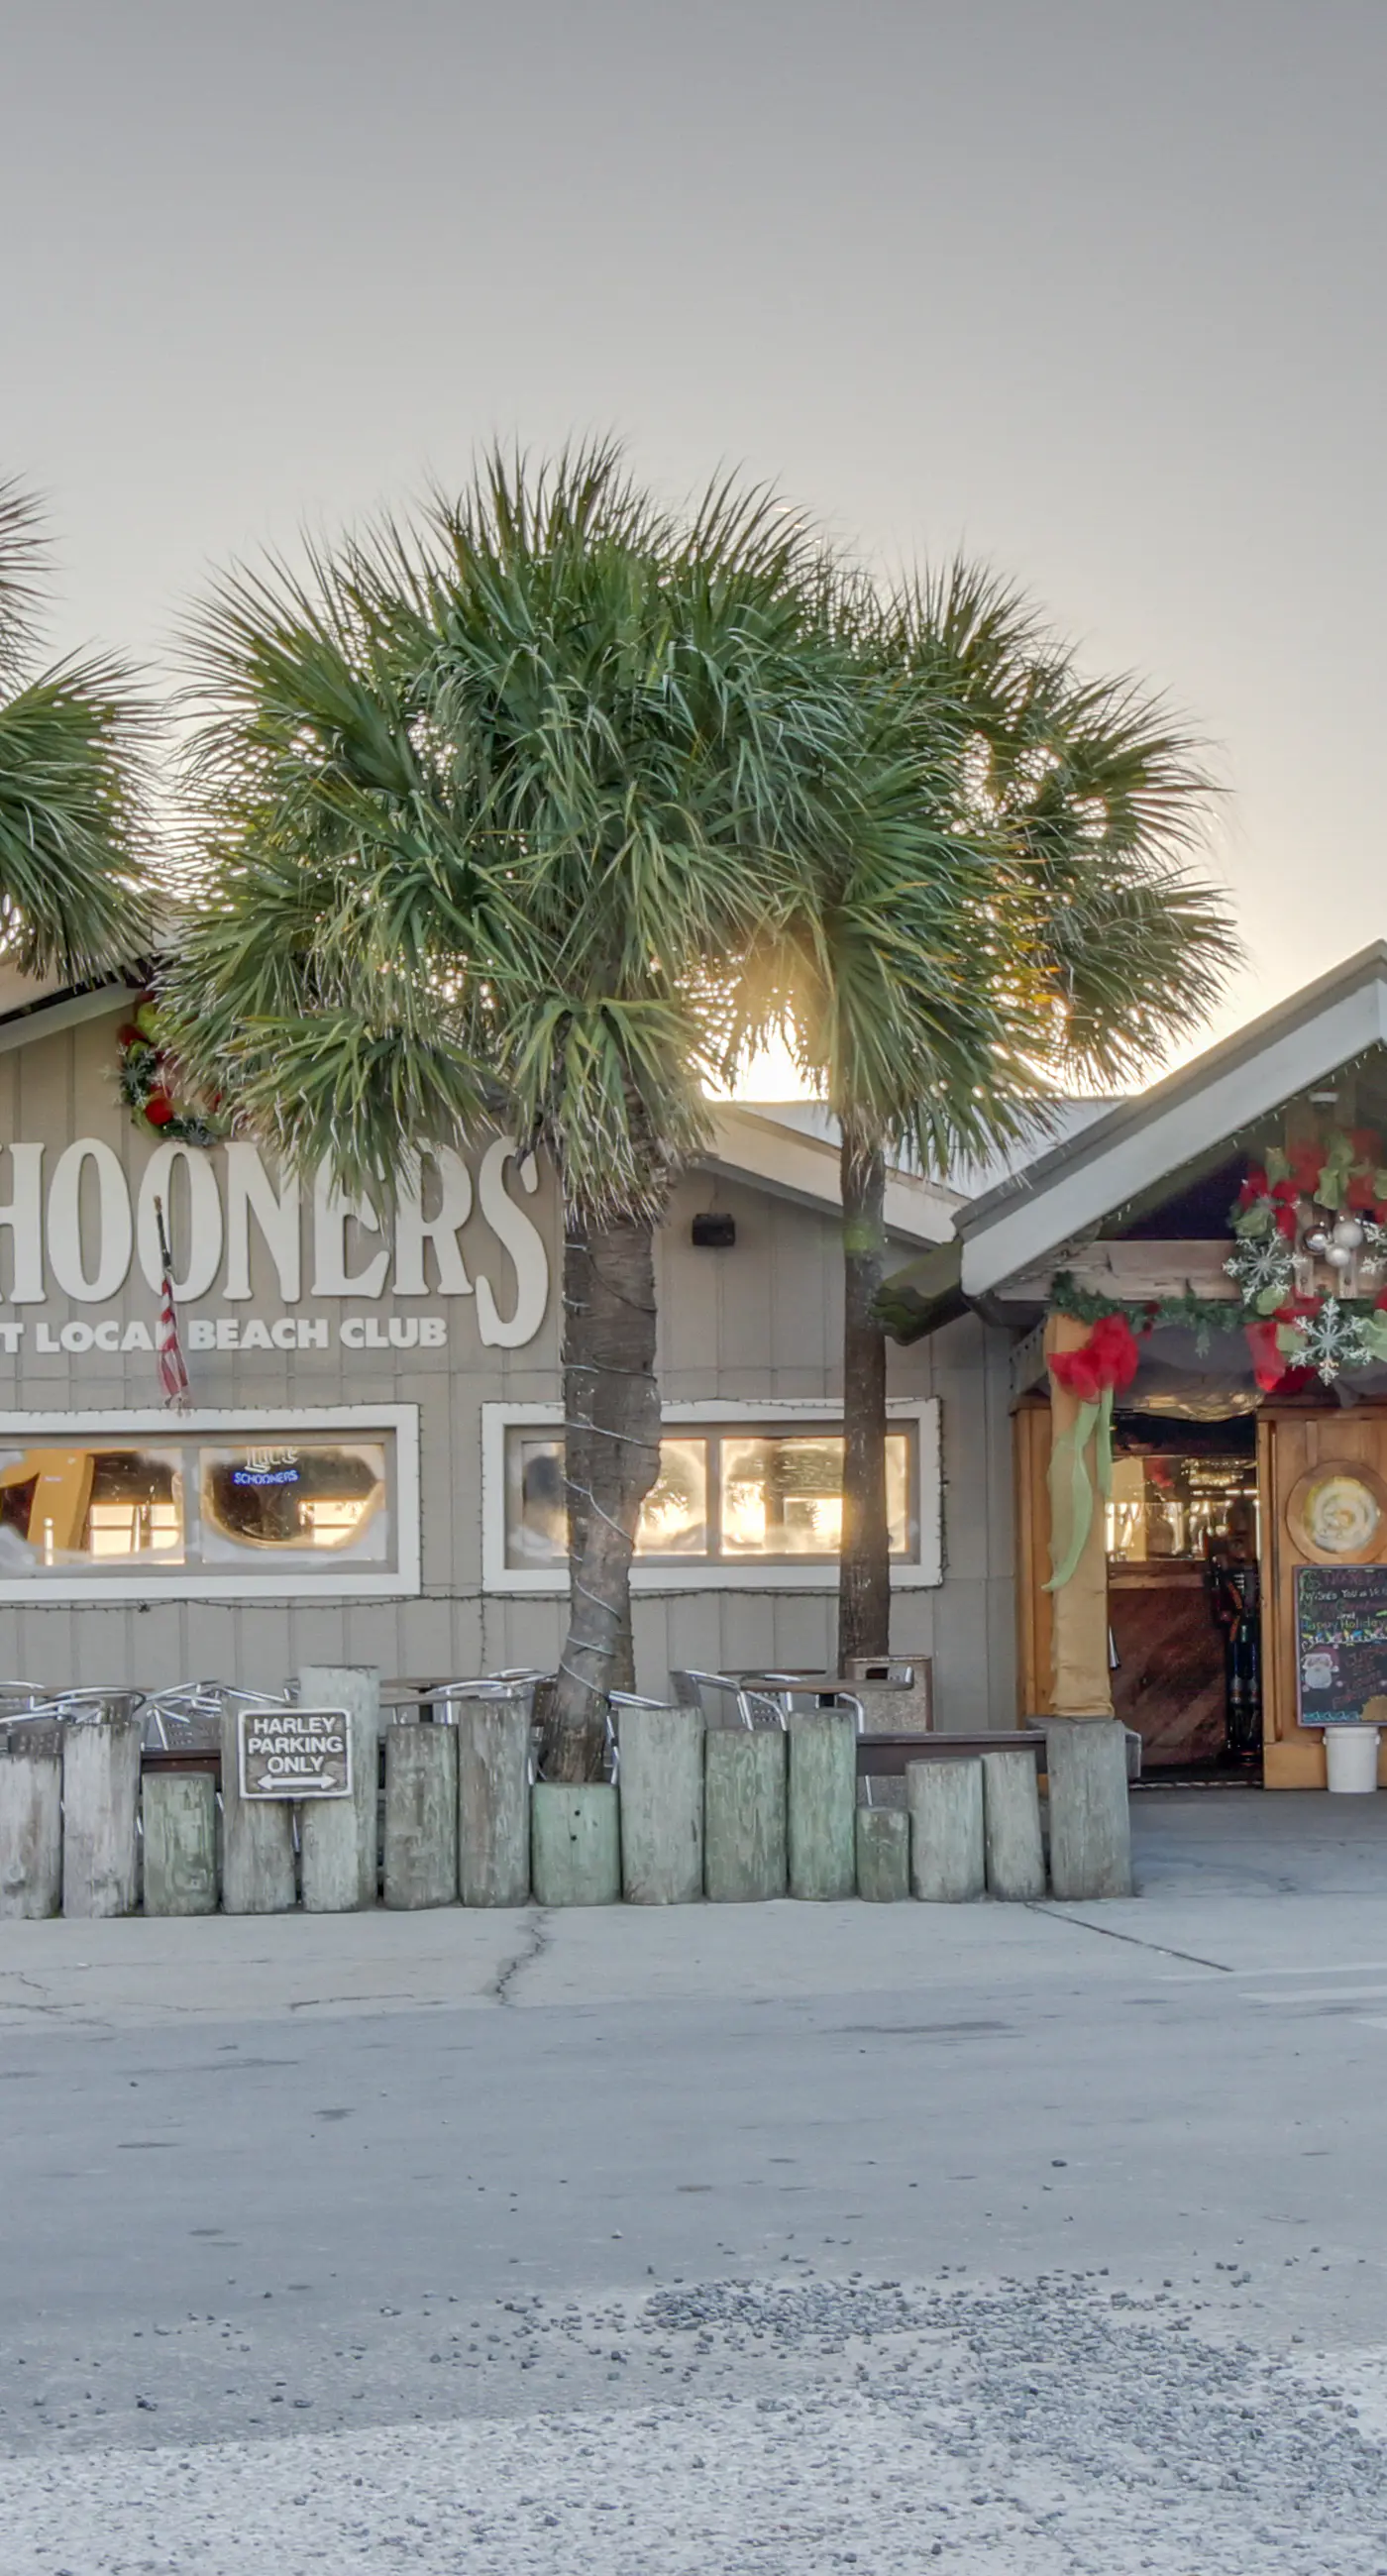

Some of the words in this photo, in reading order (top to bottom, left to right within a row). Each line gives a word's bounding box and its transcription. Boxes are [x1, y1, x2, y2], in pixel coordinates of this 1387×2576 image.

[188, 1317, 329, 1350] BEACH
[339, 1317, 448, 1349] CLUB
[253, 1716, 337, 1735] HARLEY
[248, 1736, 344, 1755] PARKING
[267, 1756, 325, 1773] ONLY
